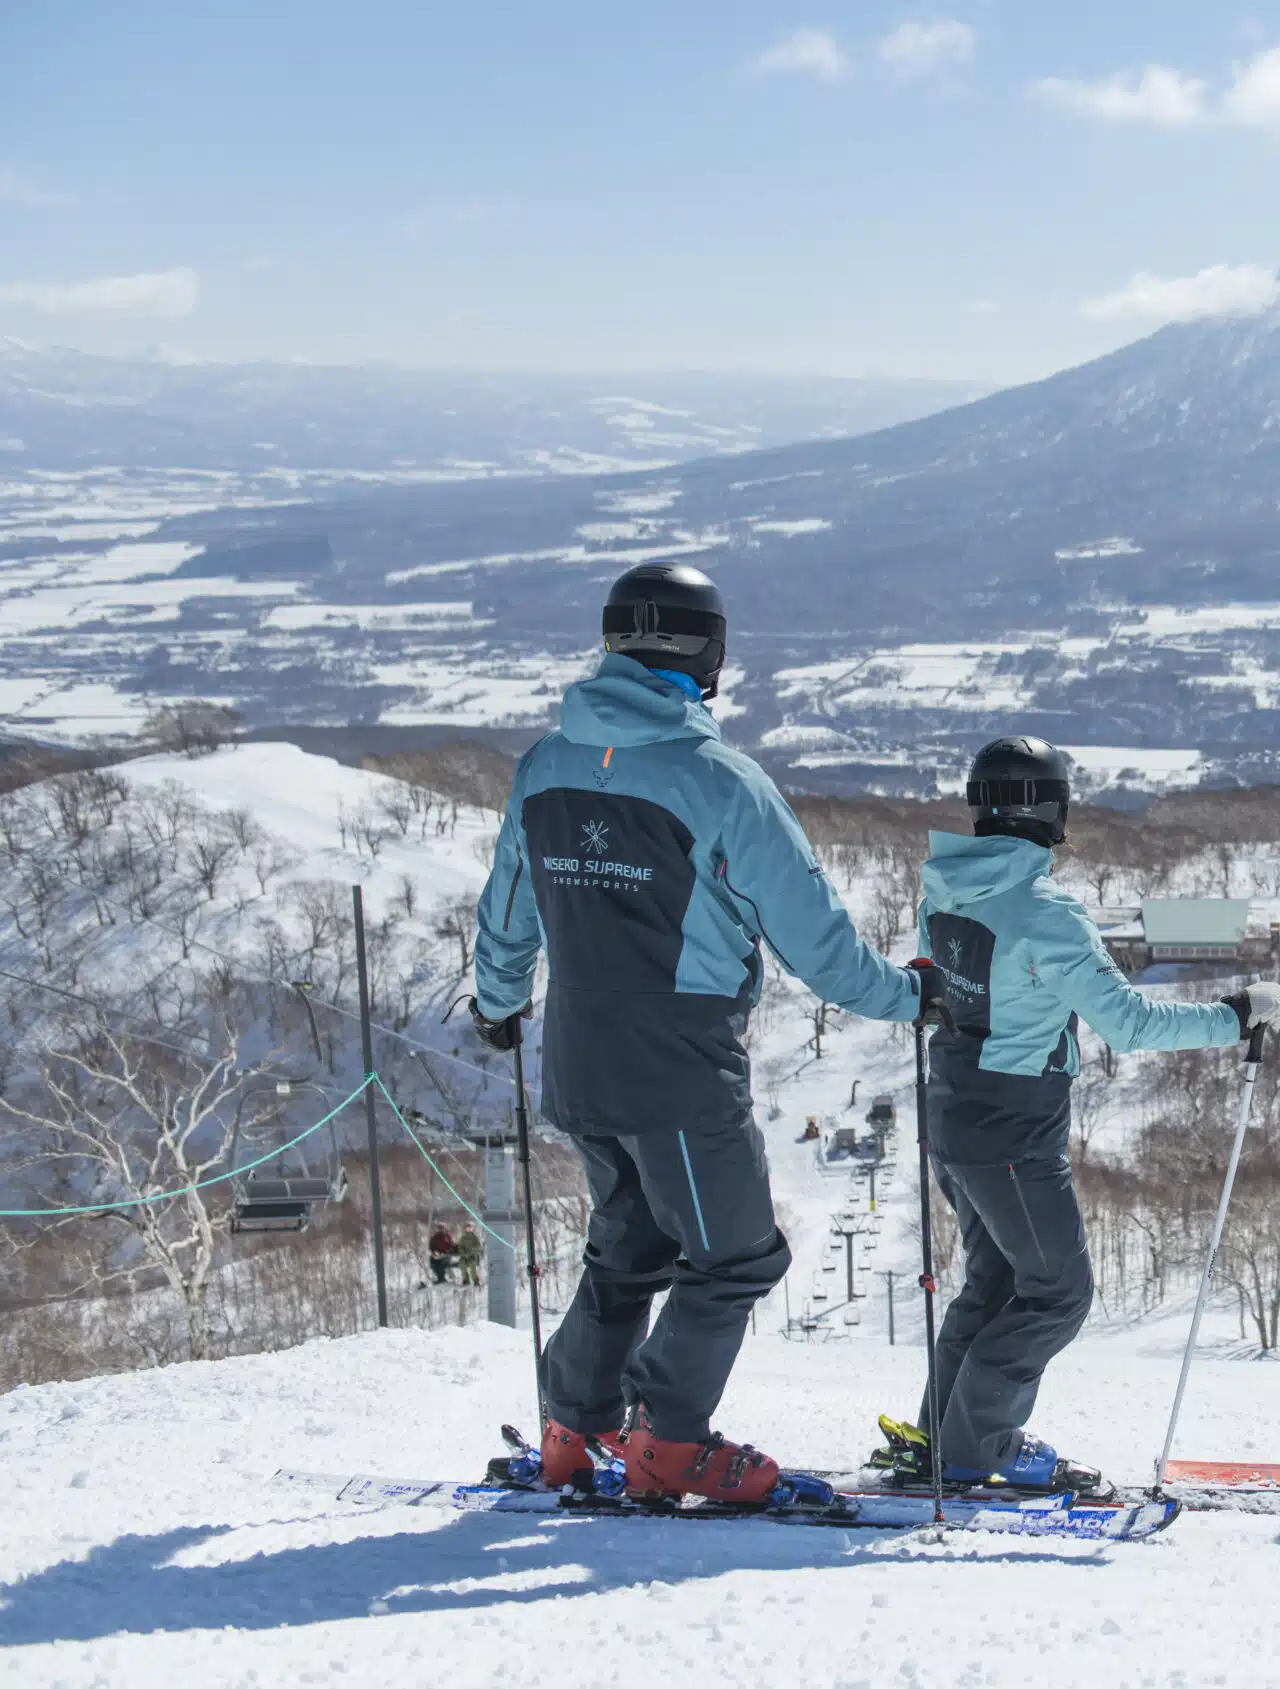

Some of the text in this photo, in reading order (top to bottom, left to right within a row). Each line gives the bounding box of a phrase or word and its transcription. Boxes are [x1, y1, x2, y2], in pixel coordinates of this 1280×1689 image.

[543, 856, 653, 881] NISEKO SUPREME
[553, 876, 639, 892] SNOWSPORTS
